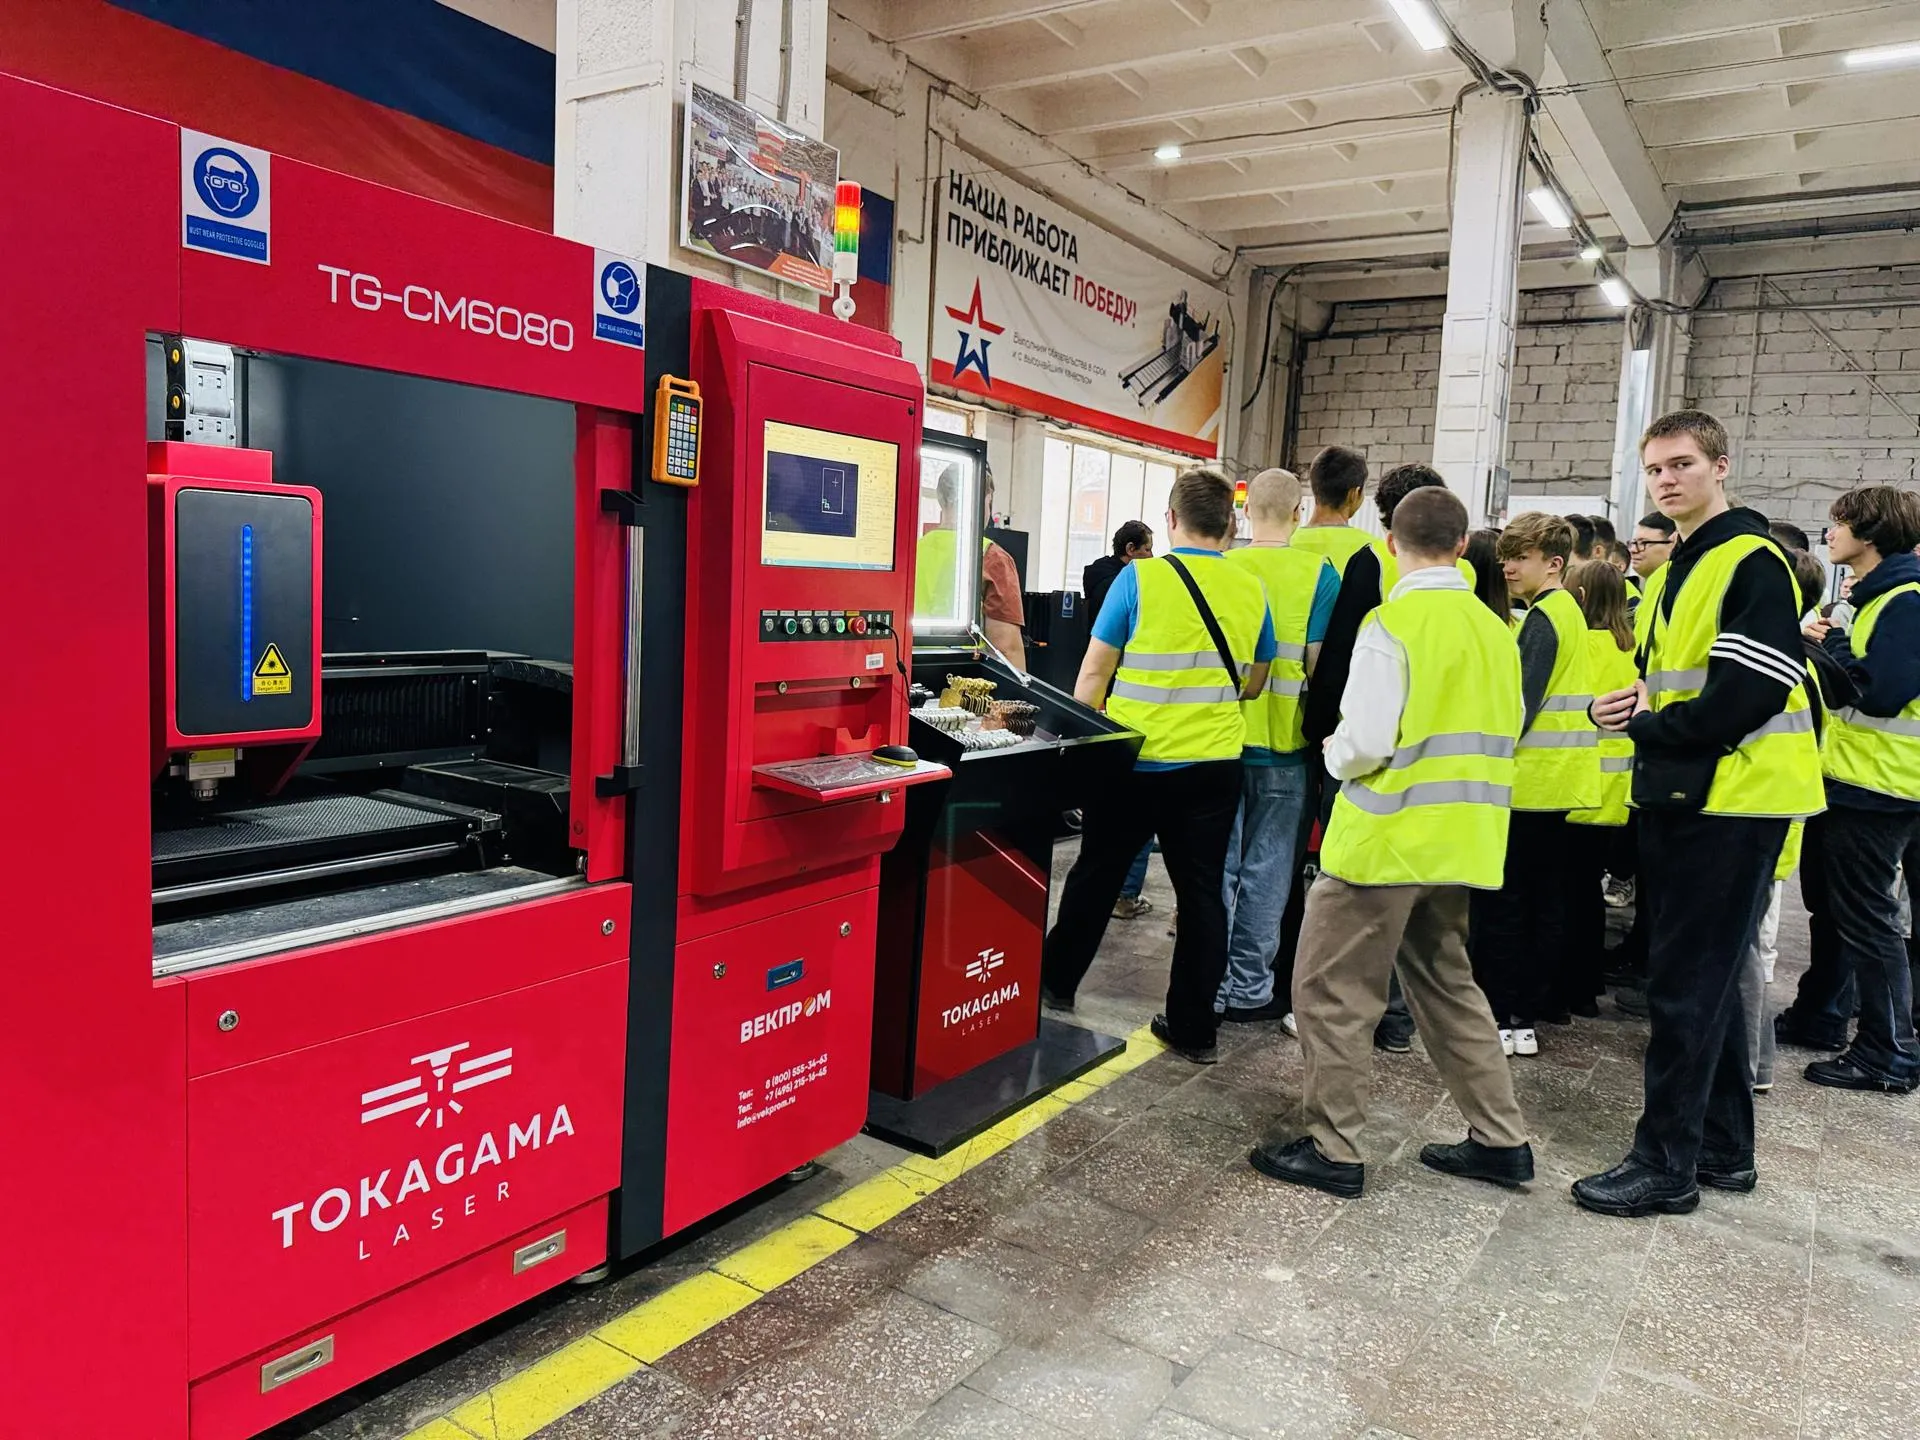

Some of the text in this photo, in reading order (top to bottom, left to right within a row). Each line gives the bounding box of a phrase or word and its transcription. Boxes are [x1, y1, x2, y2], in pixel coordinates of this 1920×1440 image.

[189, 227, 265, 250] MUST WEAR PROTECTIVE GOGGLES
[949, 169, 1078, 264] НАША РАБОТА
[947, 211, 1137, 328] ПРИБЛИЖАЕТ ПОБЕДУ!
[318, 264, 574, 352] TG-CM6080
[740, 989, 832, 1043] ВЕКПРОМ
[942, 980, 1020, 1028] TOKAGAMA
[962, 1012, 1000, 1036] LASER
[764, 1091, 774, 1101] +7
[774, 1082, 793, 1099] (495)
[772, 1070, 791, 1087] (800)
[736, 1095, 796, 1129] info@vekprom.ru
[272, 1104, 576, 1249] TOKAGAMA
[358, 1181, 511, 1261] LASER
